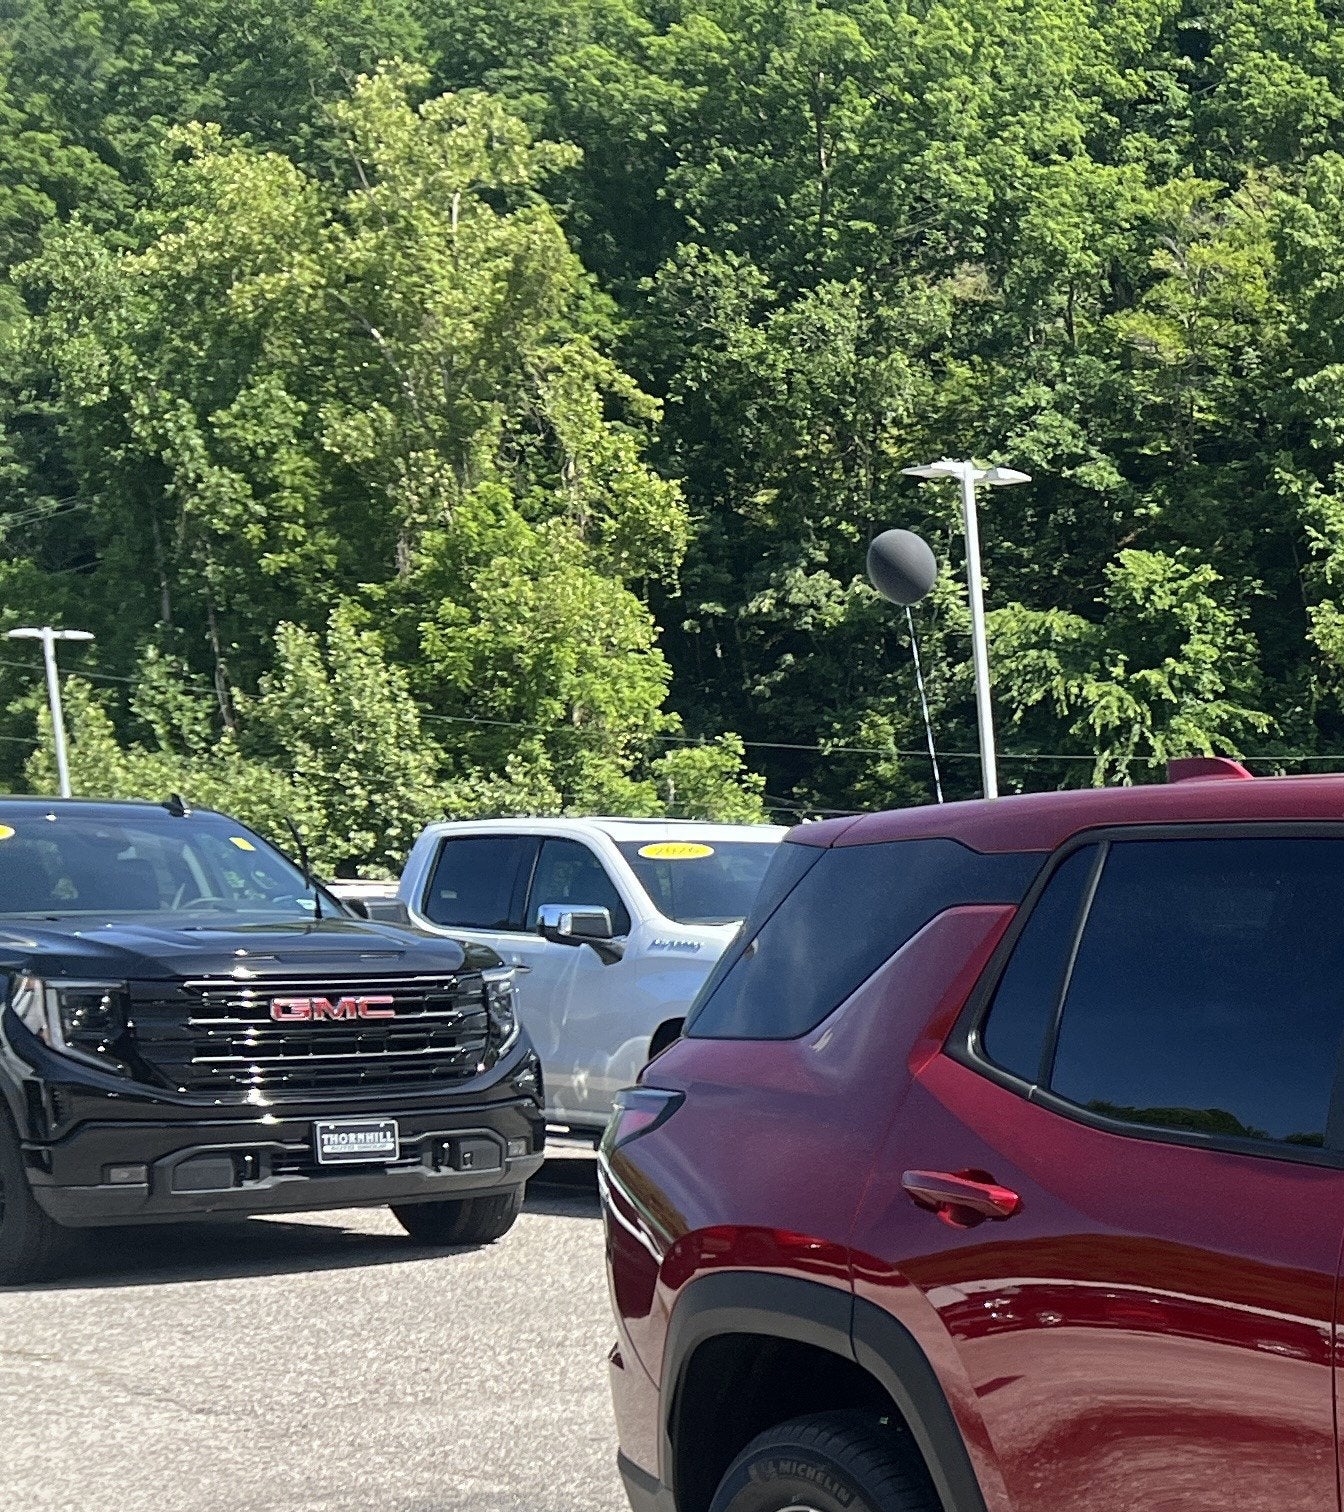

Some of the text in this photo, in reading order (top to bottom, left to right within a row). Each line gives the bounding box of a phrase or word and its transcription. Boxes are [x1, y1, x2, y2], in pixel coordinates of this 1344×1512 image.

[270, 995, 395, 1021] GMC
[322, 1131, 394, 1146] THORNHILL
[780, 1461, 851, 1501] MICHELIN
